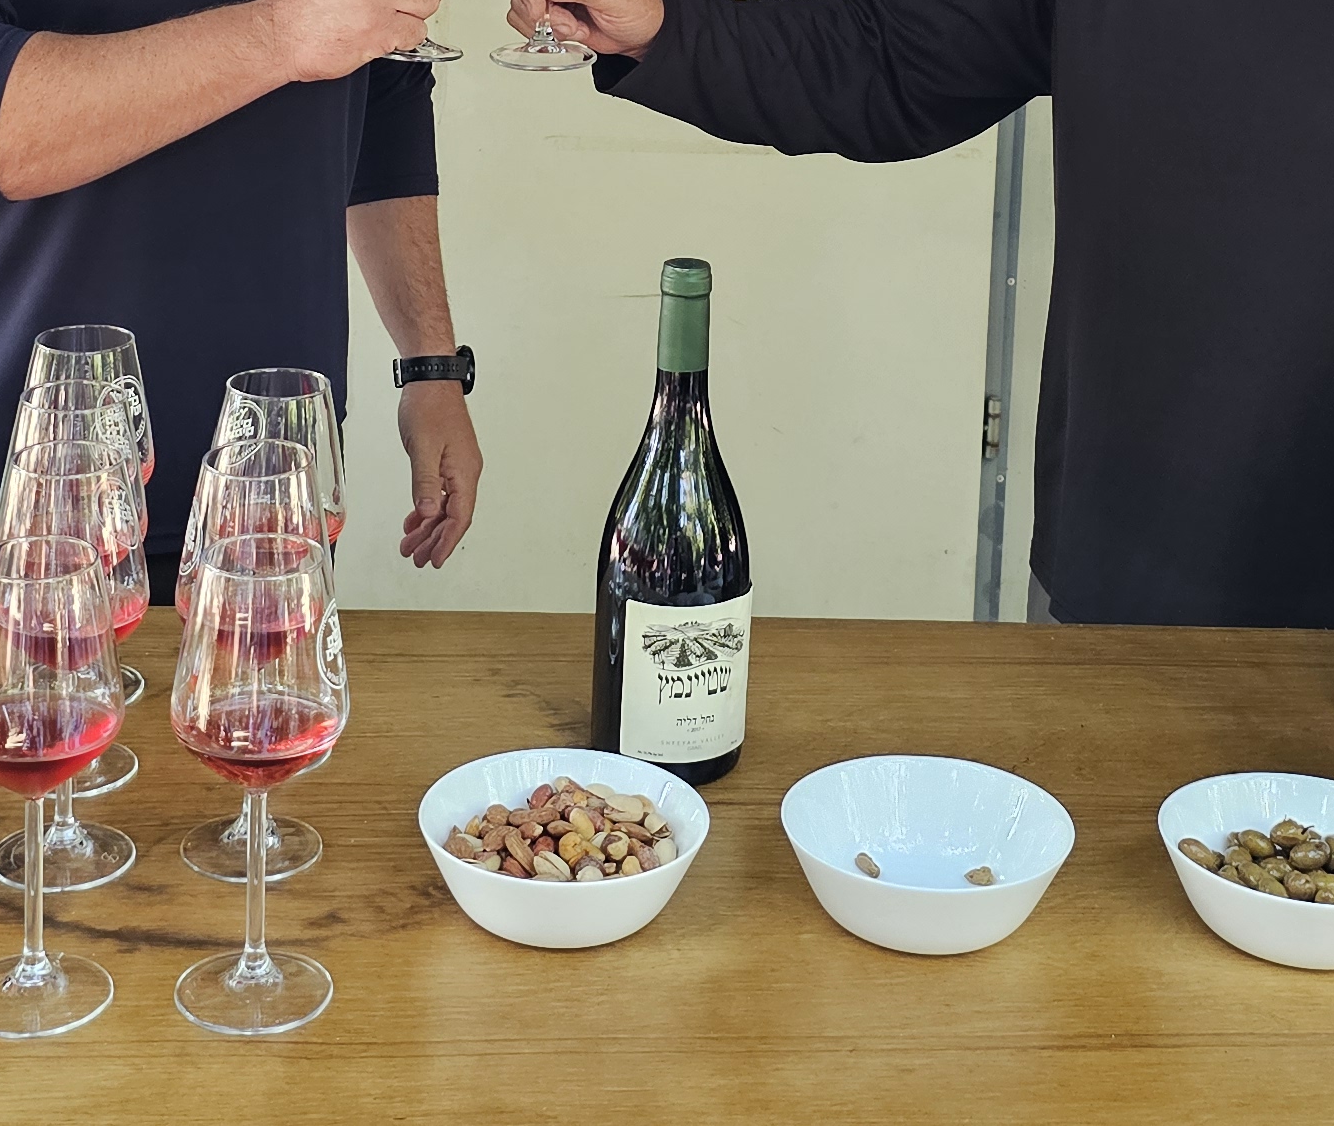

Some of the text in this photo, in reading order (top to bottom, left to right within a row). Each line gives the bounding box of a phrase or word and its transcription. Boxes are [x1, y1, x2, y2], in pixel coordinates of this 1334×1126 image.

[657, 666, 732, 705] שטיינמץ
[676, 714, 715, 727] נחל דליה
